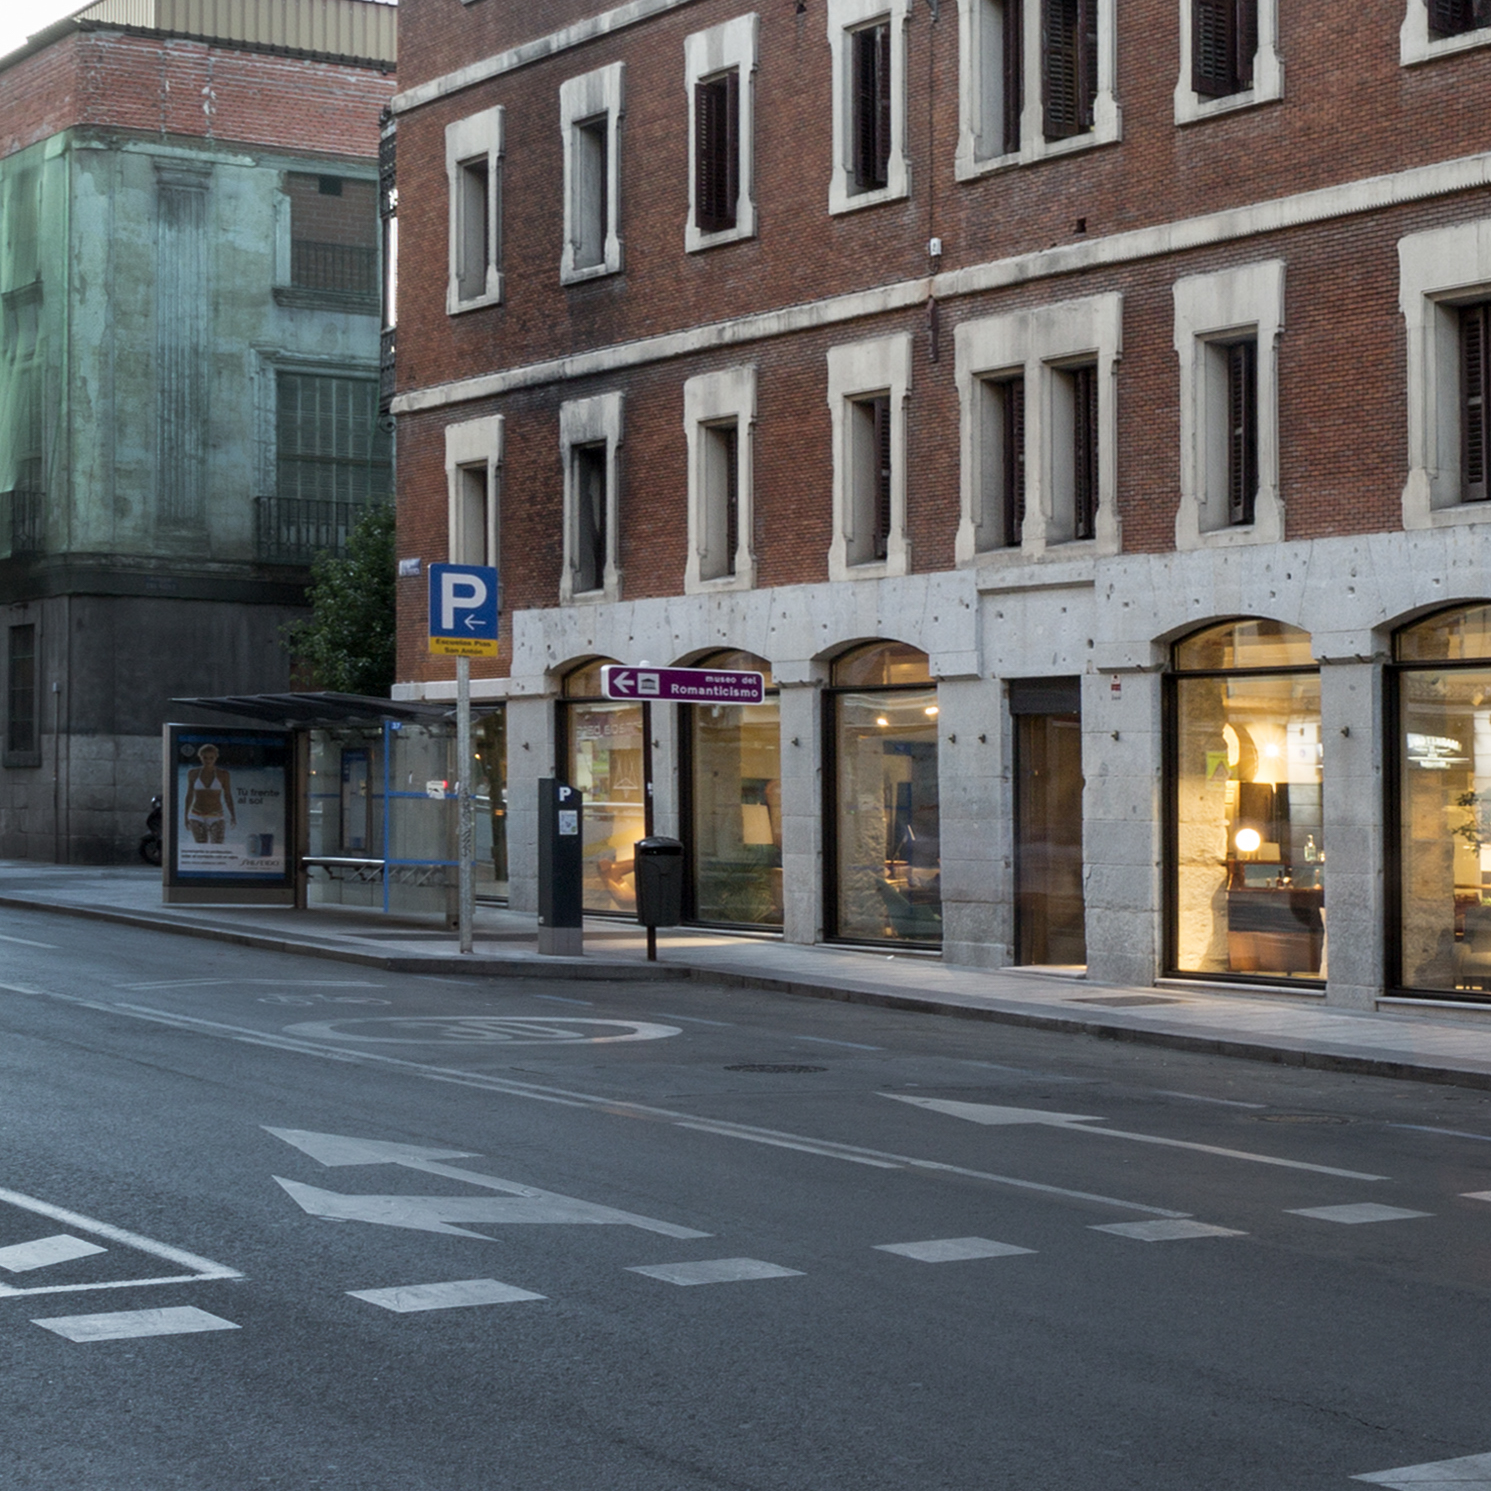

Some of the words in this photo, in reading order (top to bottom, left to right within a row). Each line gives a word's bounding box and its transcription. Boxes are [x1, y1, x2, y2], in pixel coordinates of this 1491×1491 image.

[441, 572, 487, 629] P
[671, 683, 759, 698] Romanticismo
[250, 788, 280, 797] frente
[559, 787, 572, 801] P
[237, 797, 246, 805] al
[248, 797, 263, 805] sol
